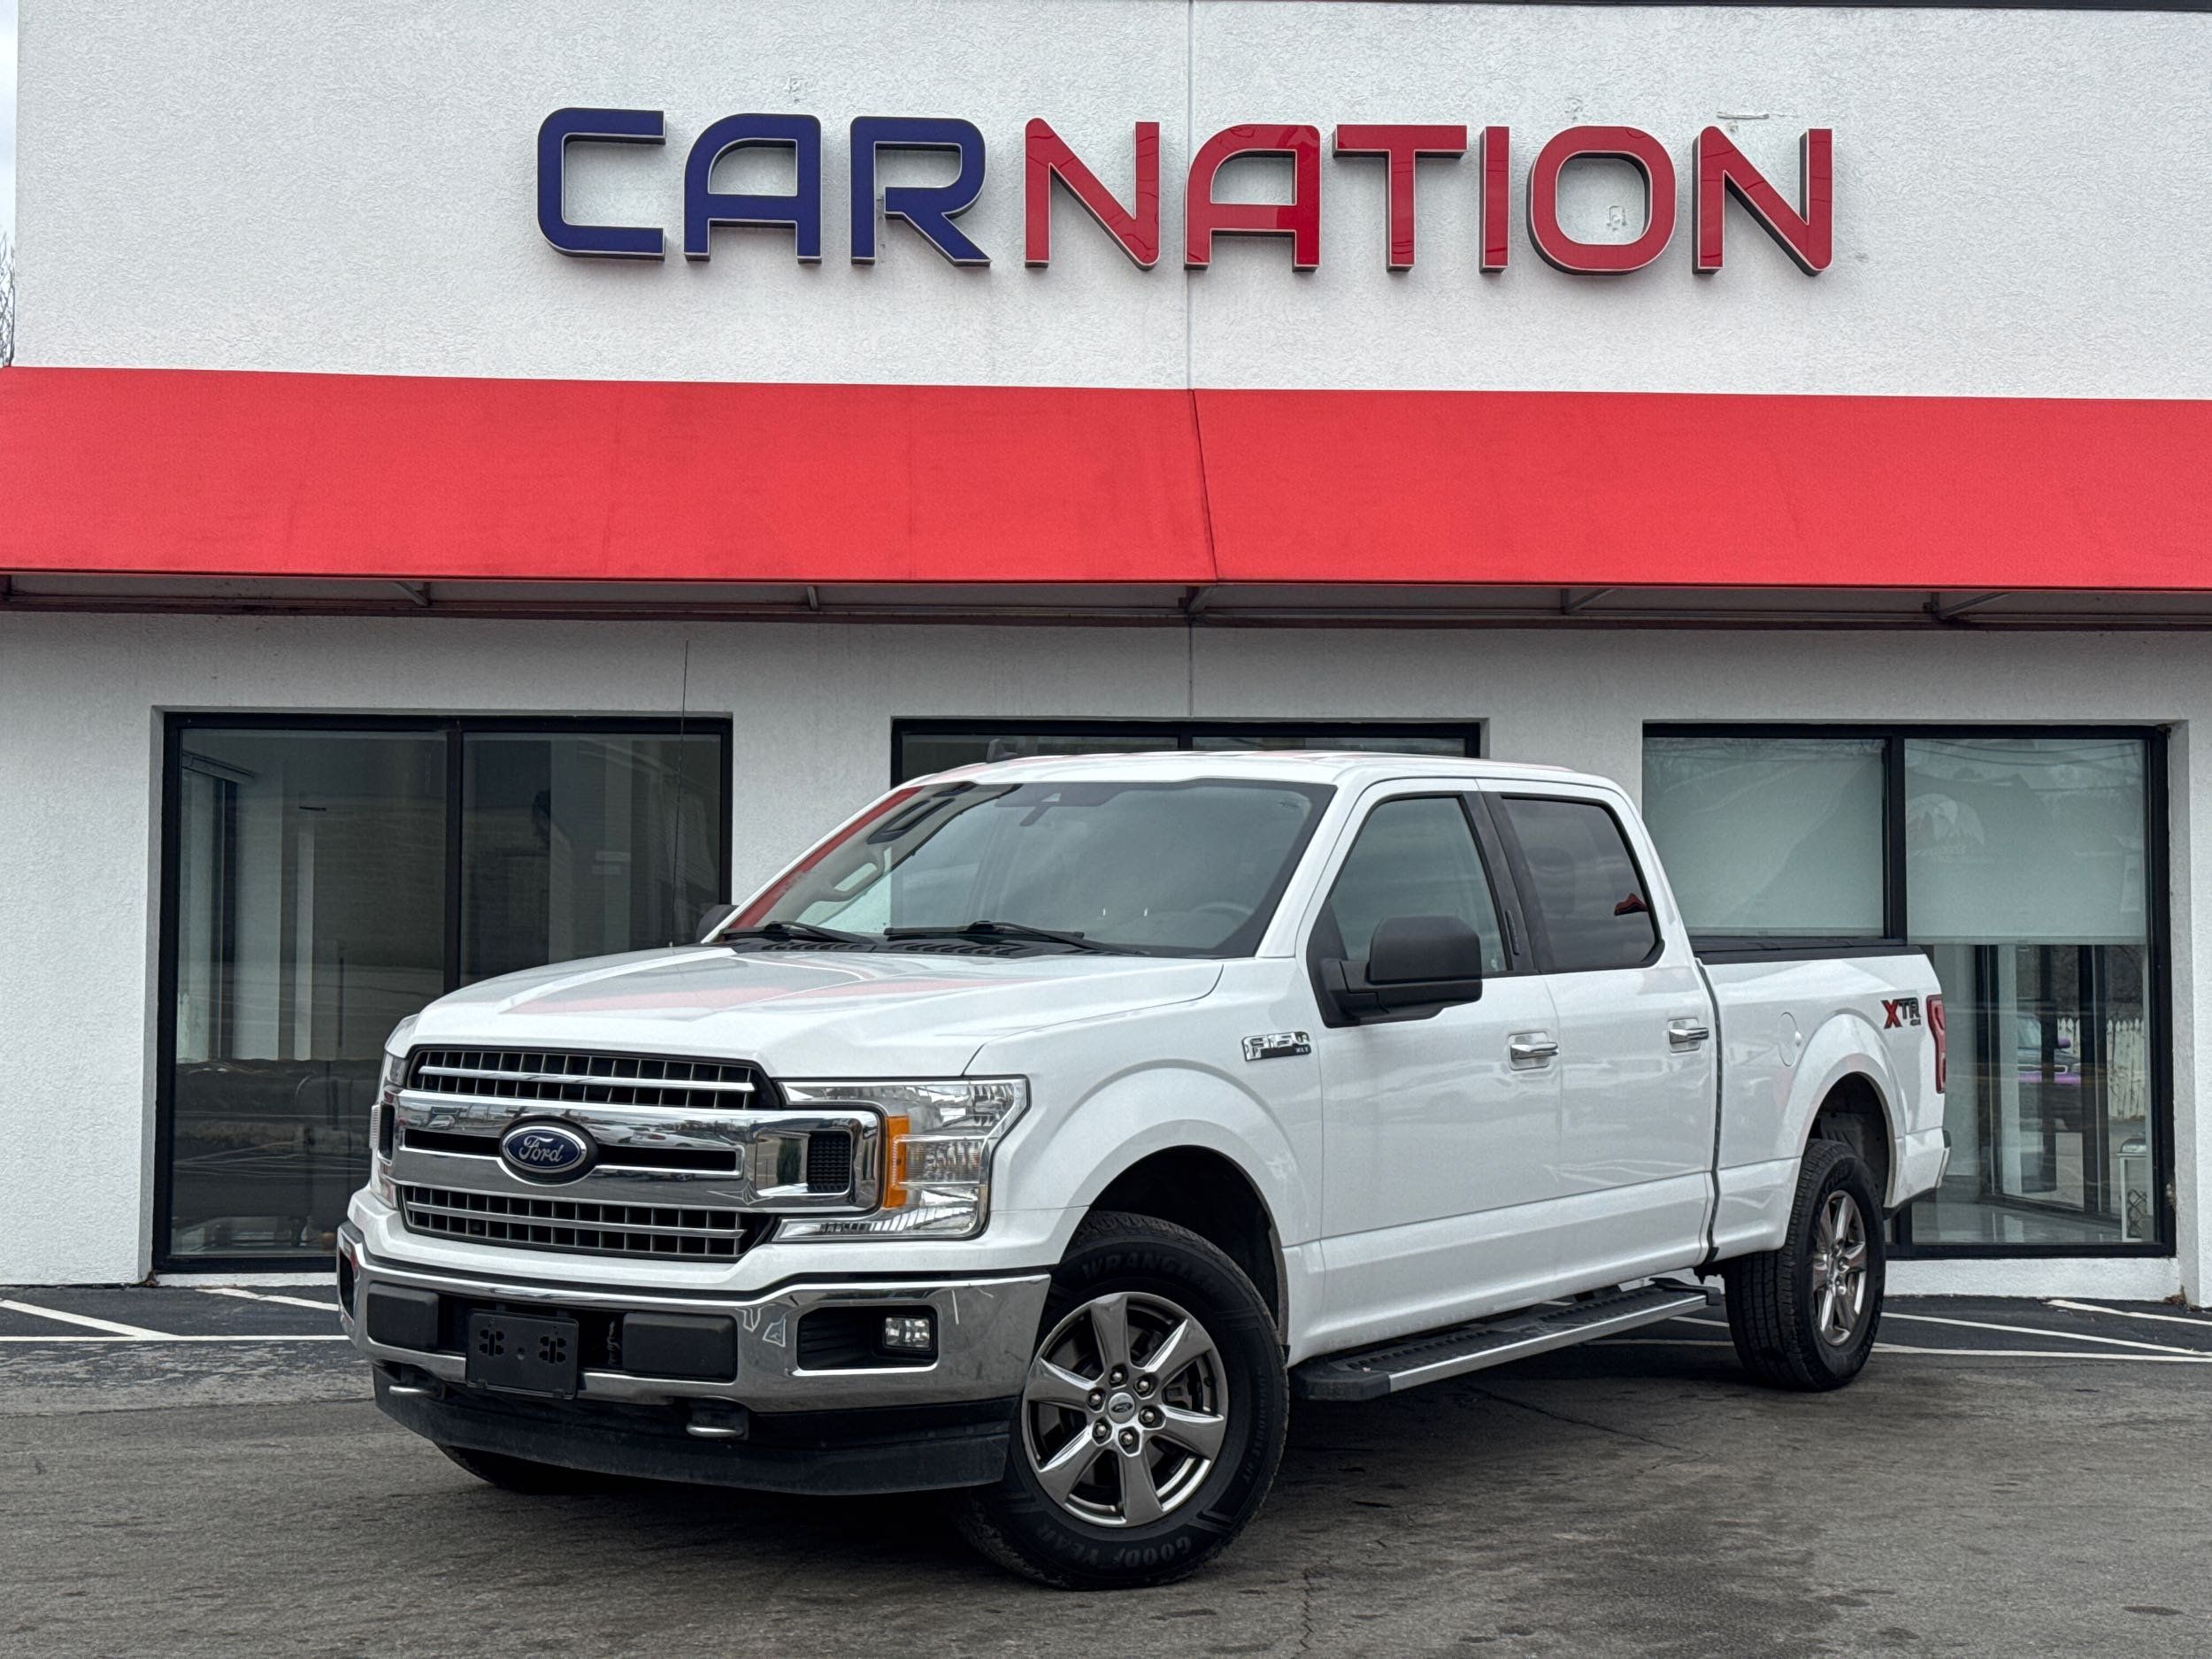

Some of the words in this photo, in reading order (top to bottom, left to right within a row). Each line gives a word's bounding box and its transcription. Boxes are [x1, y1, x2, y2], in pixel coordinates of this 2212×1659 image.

[538, 107, 1833, 276] CARNATION
[1880, 996, 1921, 1030] XTR
[518, 1134, 565, 1162] Ford
[1081, 1251, 1218, 1297] WRANGL
